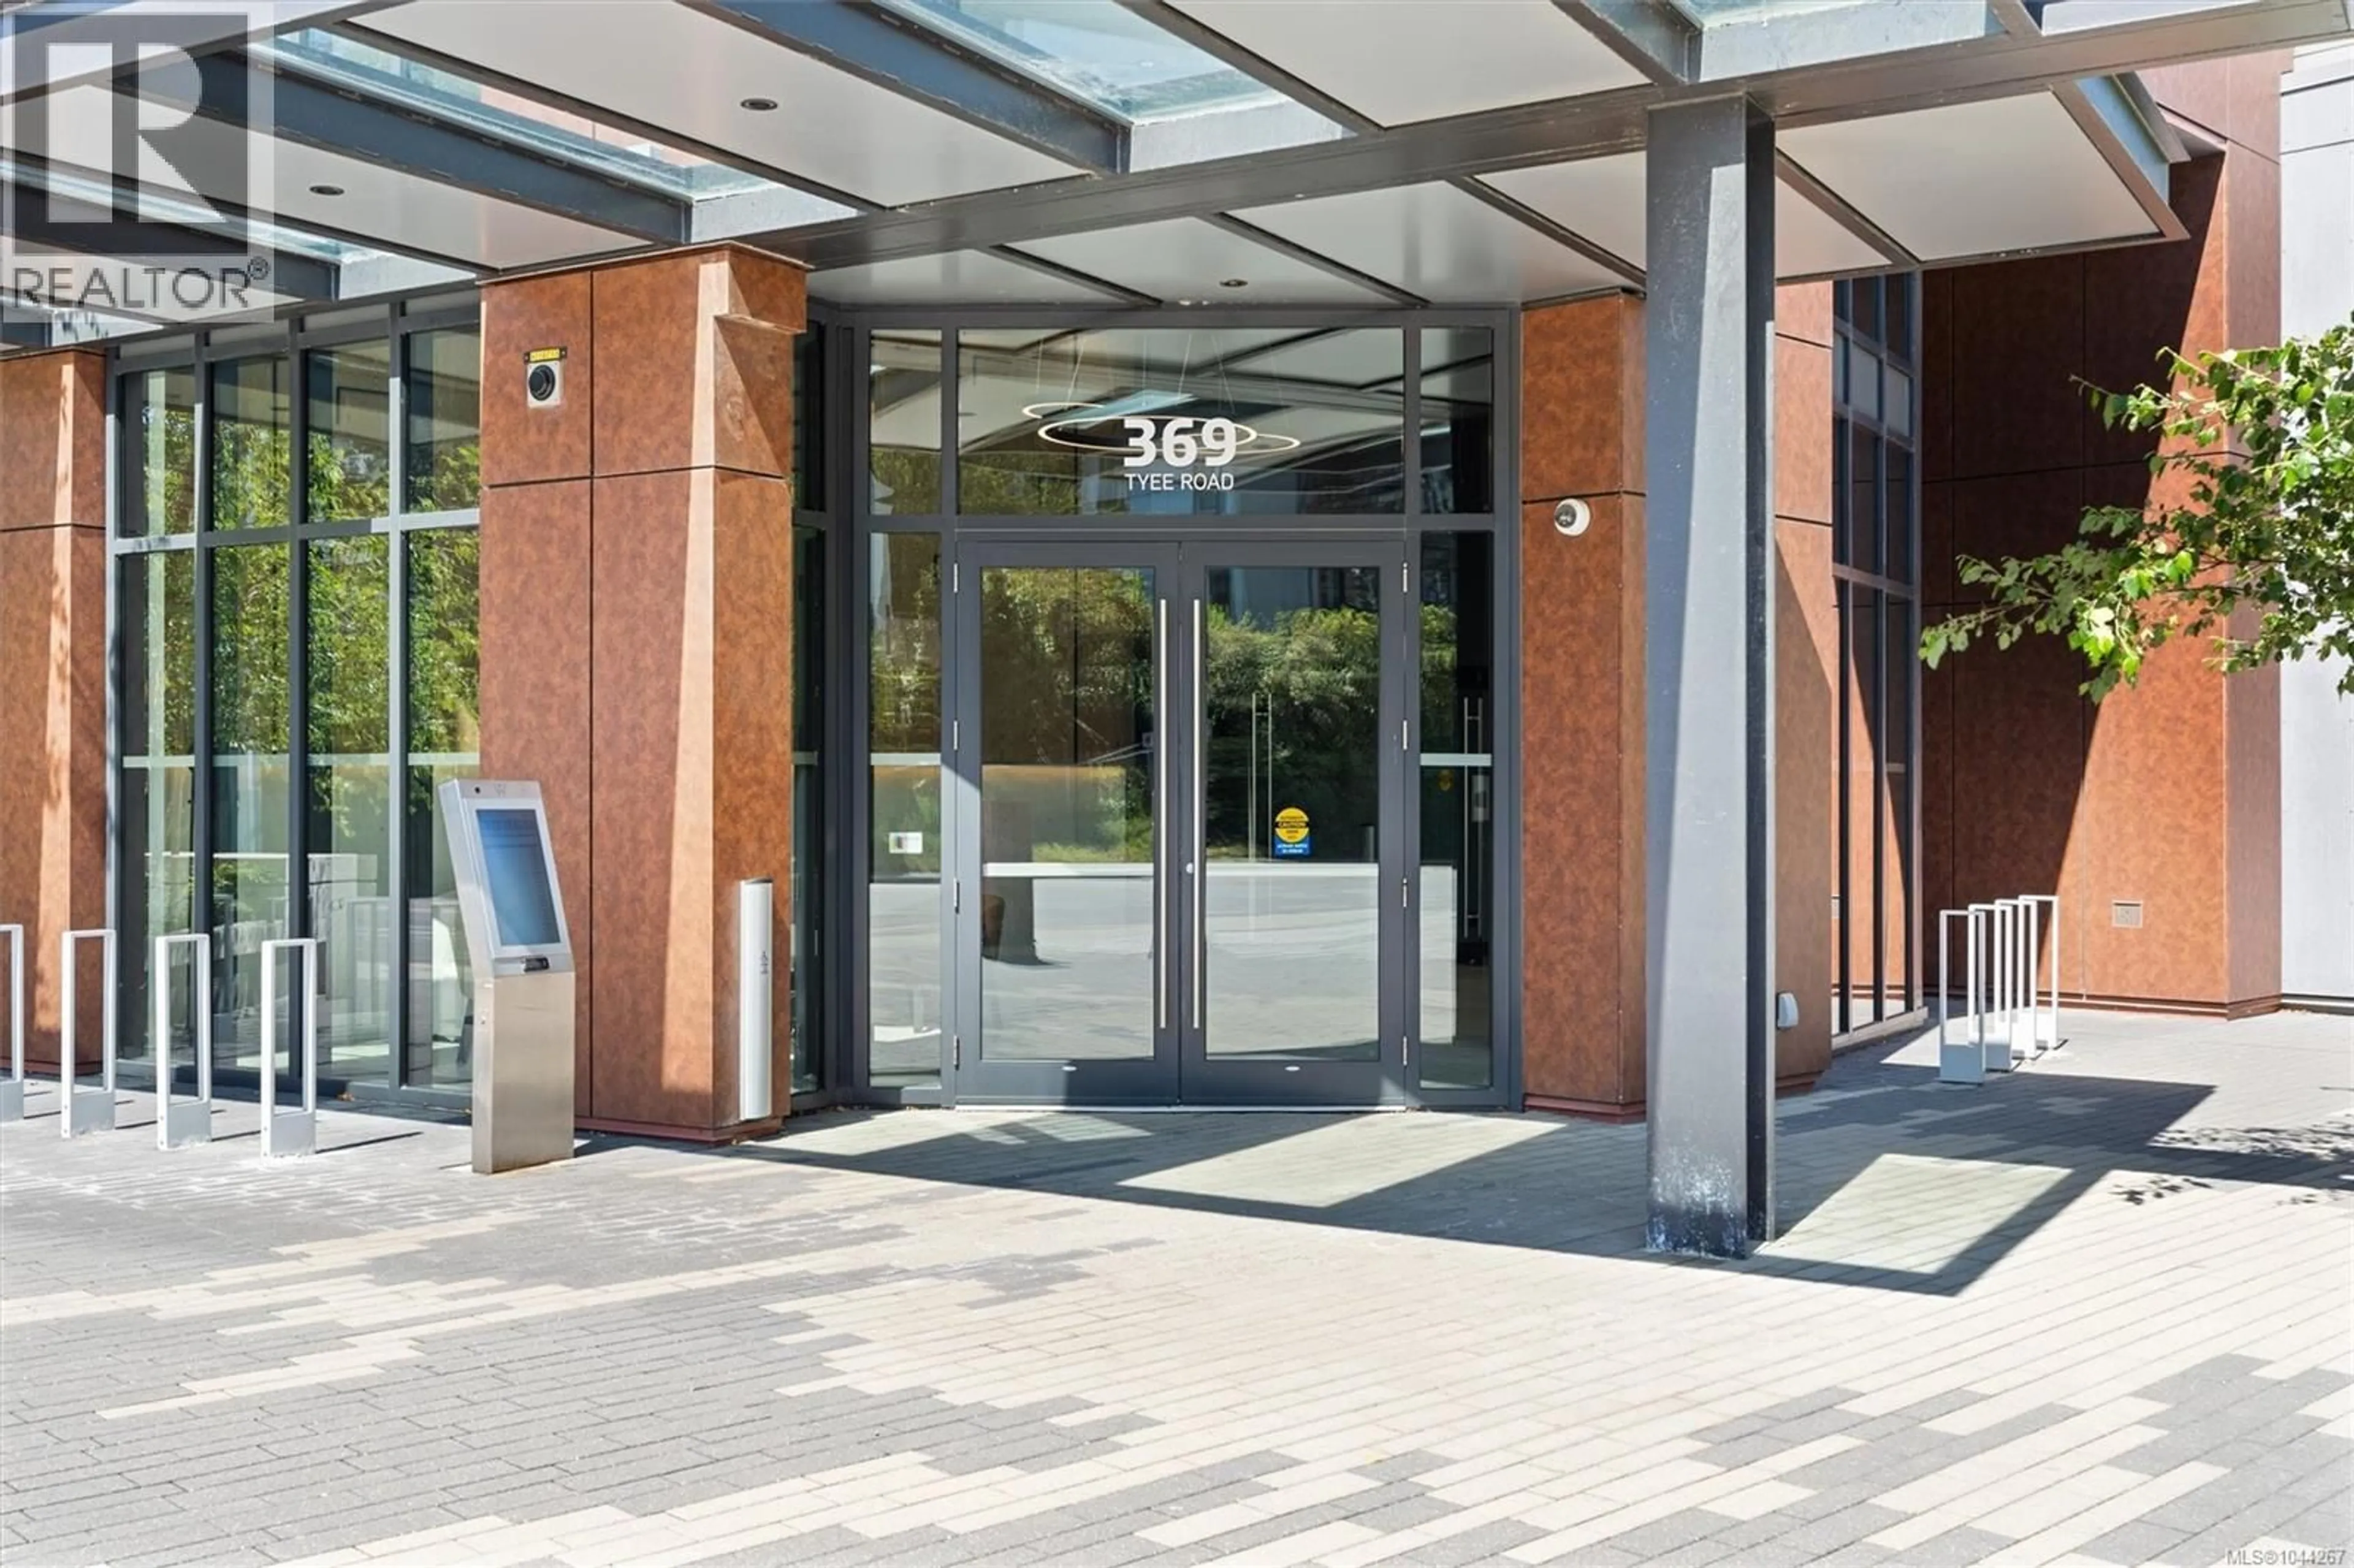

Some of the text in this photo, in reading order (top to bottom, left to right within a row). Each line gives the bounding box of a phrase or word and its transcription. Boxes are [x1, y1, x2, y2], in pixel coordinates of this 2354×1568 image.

[1124, 417, 1236, 467] 369
[1125, 473, 1233, 490] TYEE ROAD
